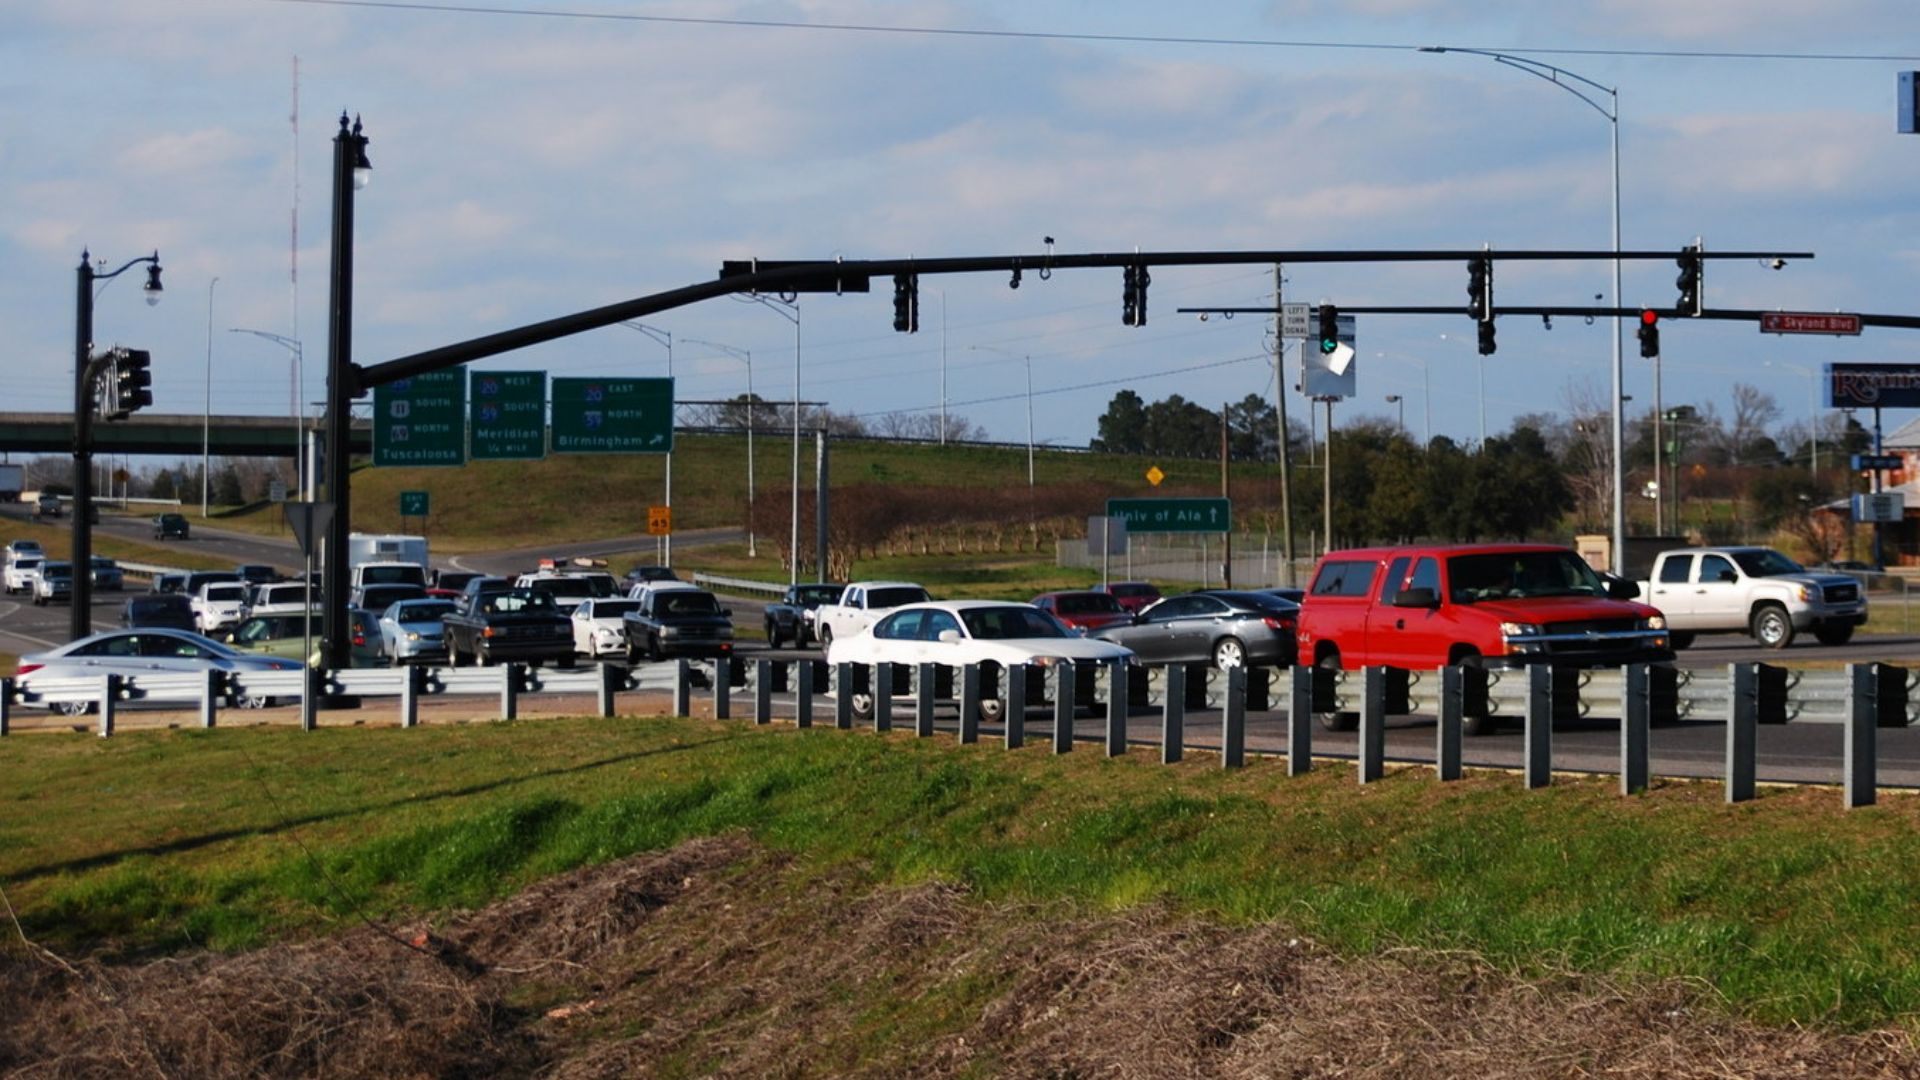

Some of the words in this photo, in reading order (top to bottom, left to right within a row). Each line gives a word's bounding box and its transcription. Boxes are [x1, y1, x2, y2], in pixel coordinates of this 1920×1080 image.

[1784, 317, 1825, 331] Skyland
[1830, 318, 1853, 330] Blvd
[608, 385, 634, 393] EAST
[416, 399, 451, 408] SOUTH
[504, 403, 539, 411] SOUTH
[608, 410, 642, 418] NORTH
[414, 424, 449, 432] NORTH
[477, 428, 538, 438] Meridian
[559, 436, 642, 449] Birmingham
[382, 448, 457, 459] Tuscaloosa
[1155, 510, 1170, 522] of
[1176, 510, 1202, 522] Ala
[651, 517, 668, 528] 45
